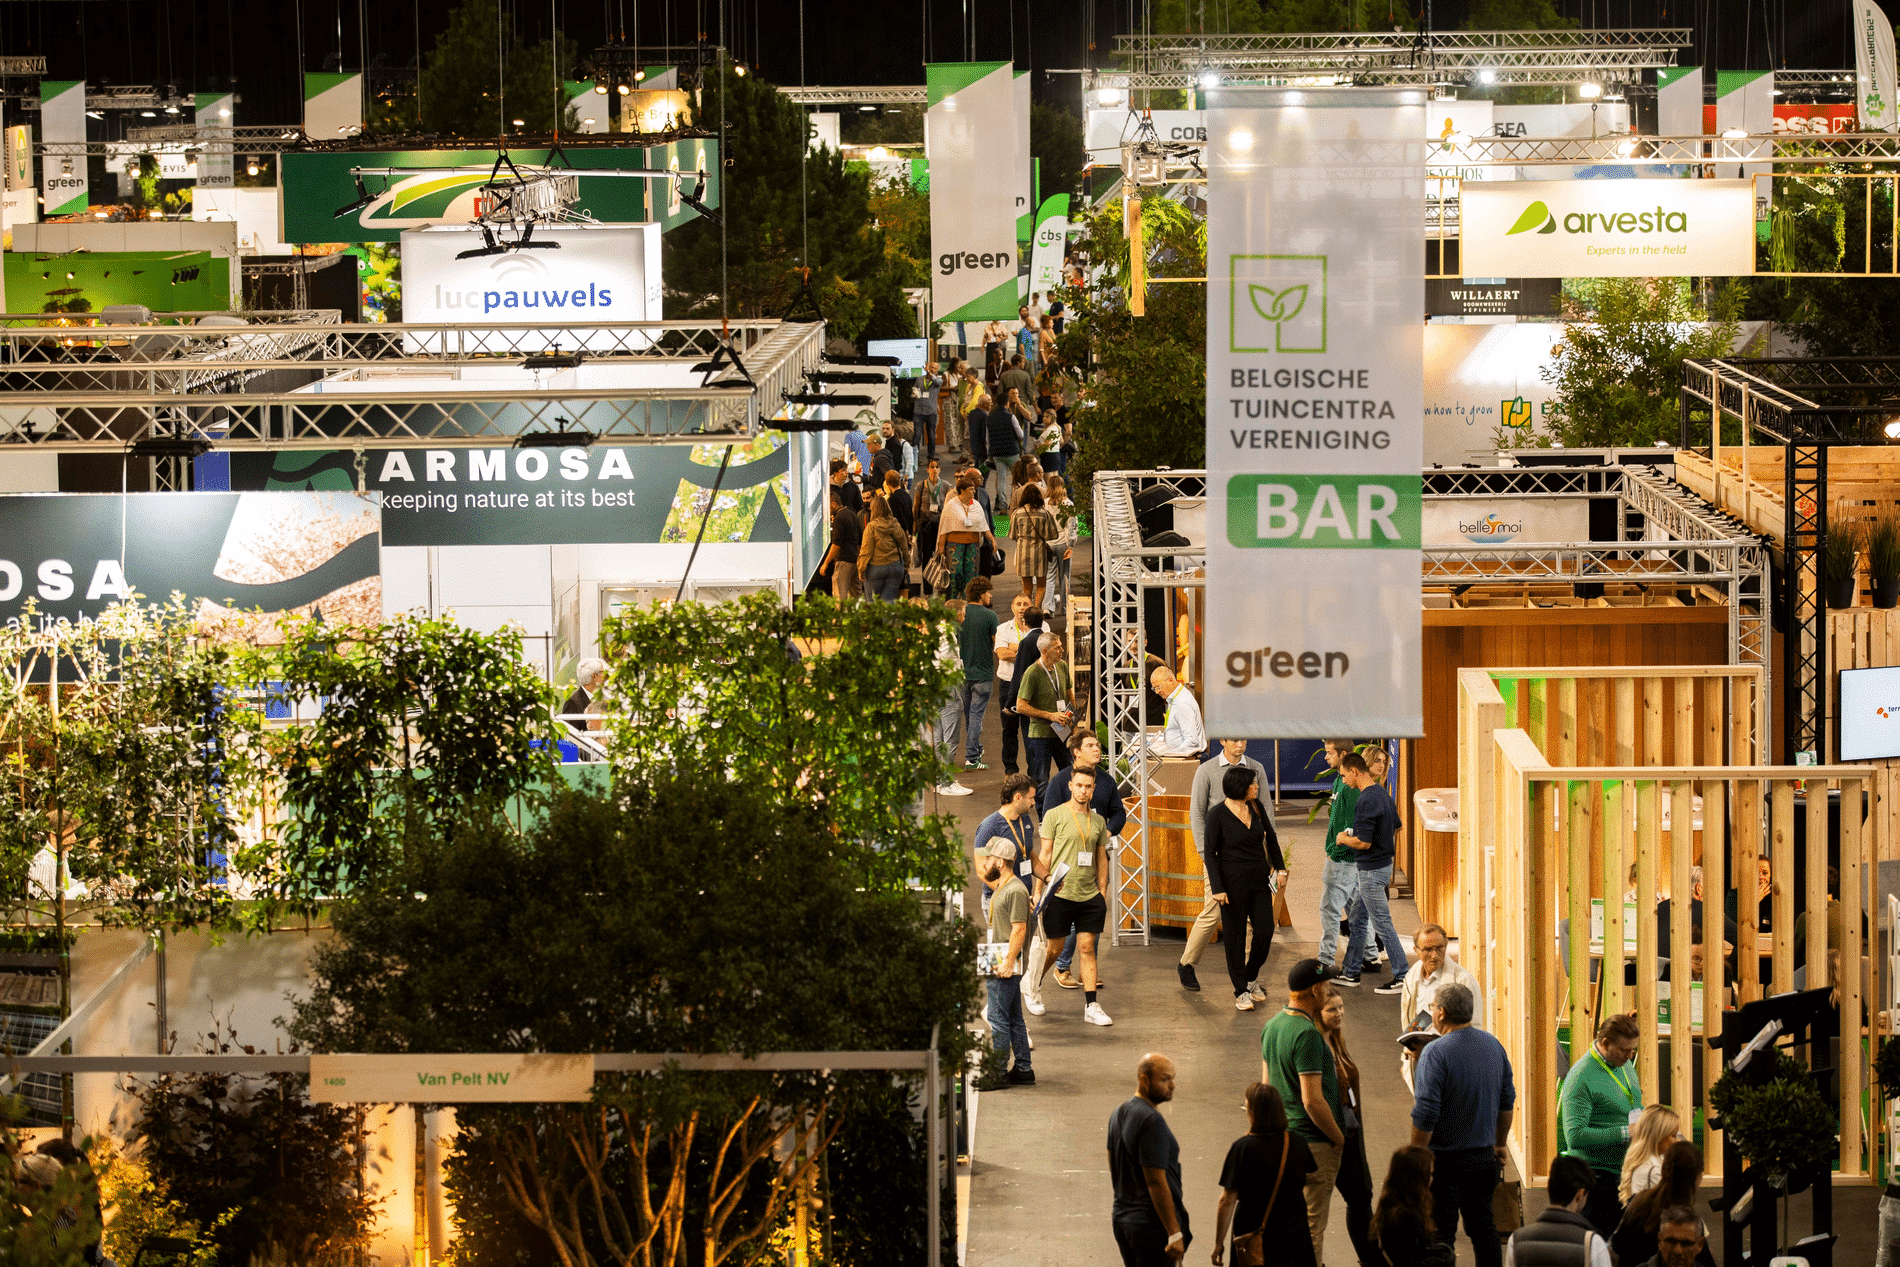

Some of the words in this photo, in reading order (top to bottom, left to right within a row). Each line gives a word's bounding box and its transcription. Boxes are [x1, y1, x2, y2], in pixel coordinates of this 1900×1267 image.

[47, 178, 84, 191] green
[200, 175, 231, 186] green
[1563, 205, 1688, 234] arvesta
[1040, 230, 1062, 241] cbs
[1586, 245, 1626, 257] Experts
[1629, 246, 1639, 255] in
[1642, 245, 1660, 255] the
[1663, 245, 1687, 255] field
[939, 251, 1010, 276] green
[1450, 291, 1520, 300] WILLAERT
[1230, 368, 1370, 389] BELGISCHE
[1229, 399, 1396, 420] TUINCENTRA
[1434, 402, 1452, 416] how
[1455, 401, 1466, 416] to
[1466, 405, 1493, 426] grow
[1229, 429, 1391, 450] VERENIGING
[378, 448, 635, 482] ARMOSA
[381, 490, 458, 513] keeping
[464, 491, 529, 509] nature
[535, 490, 555, 508] at
[561, 489, 585, 507] its
[591, 488, 636, 507] best
[1256, 483, 1401, 540] BAR
[1226, 646, 1350, 689] green
[416, 1072, 447, 1086] Van
[452, 1072, 482, 1086] Pelt
[486, 1072, 510, 1086] NV
